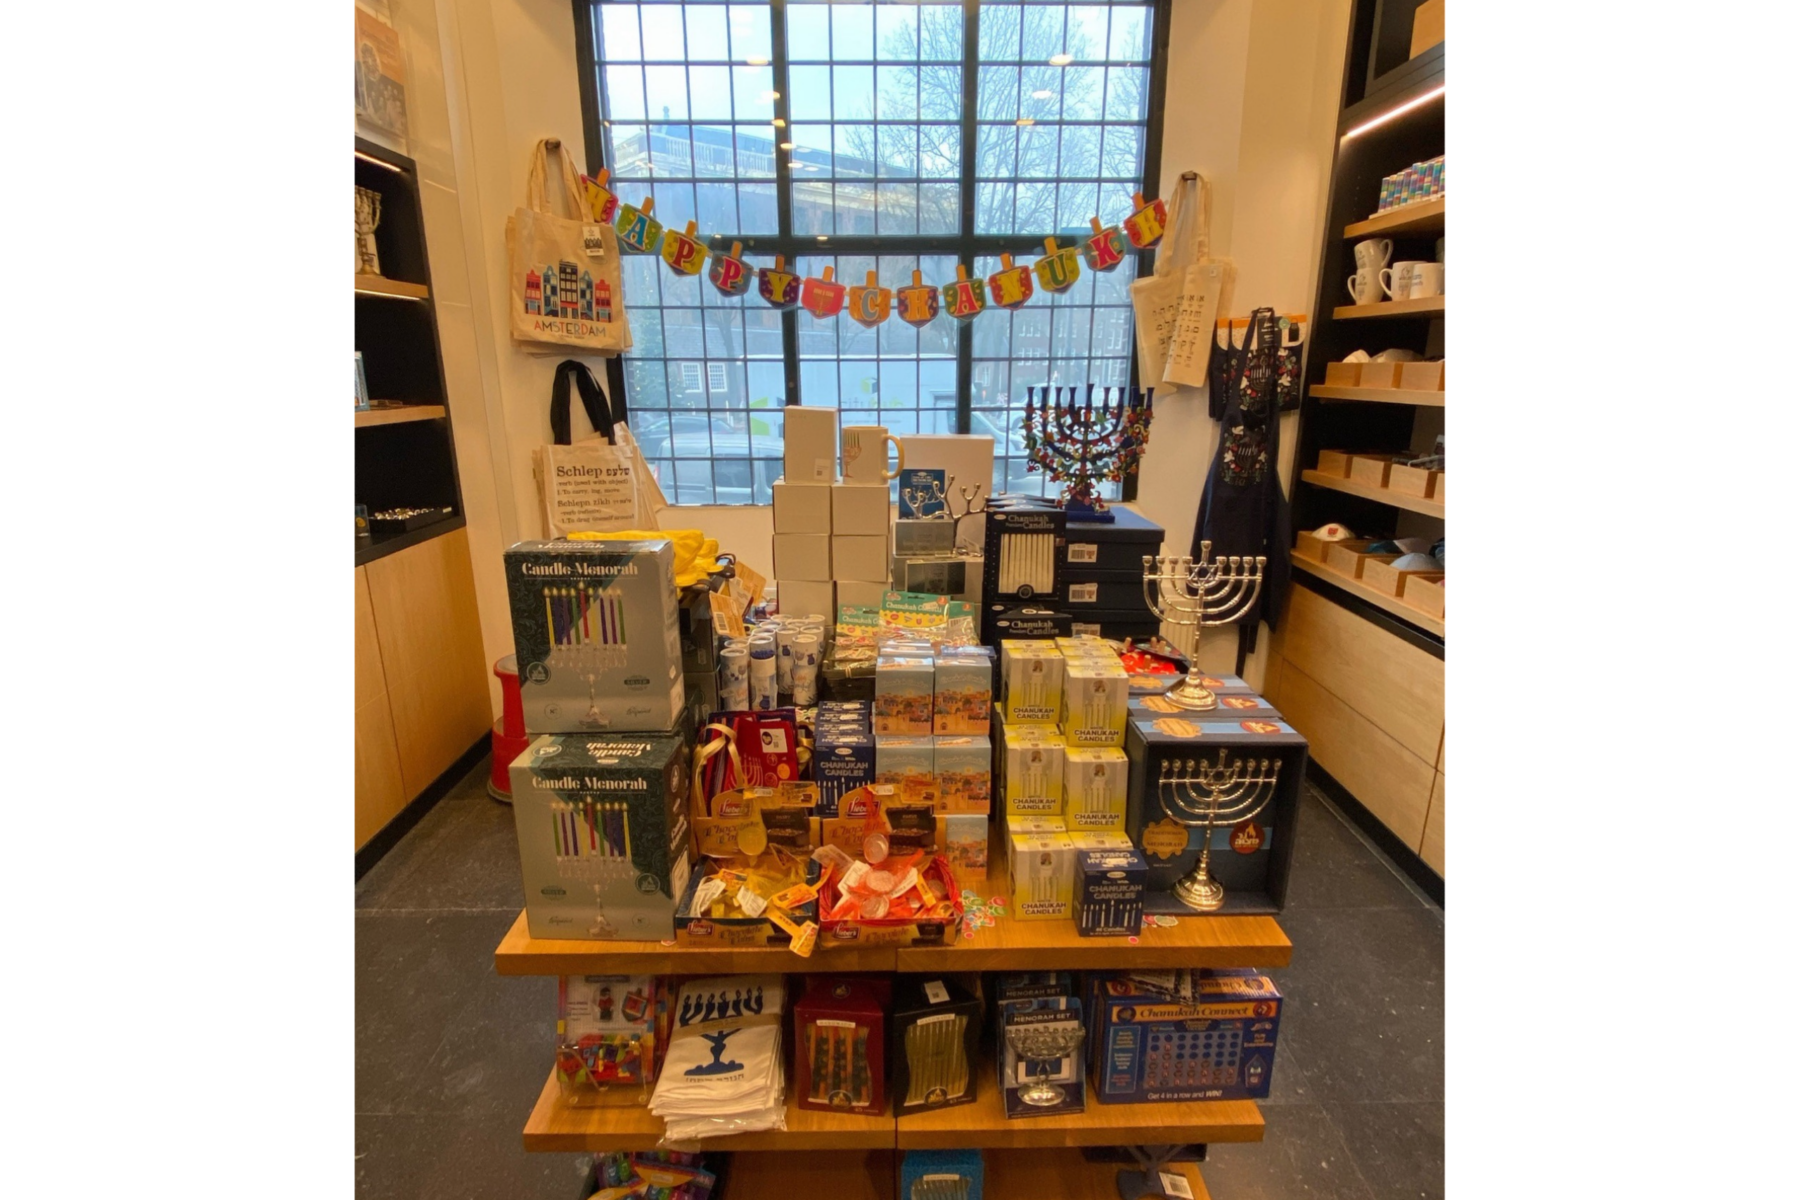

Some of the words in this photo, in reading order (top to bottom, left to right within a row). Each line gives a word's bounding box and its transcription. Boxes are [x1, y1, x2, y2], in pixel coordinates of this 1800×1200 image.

[534, 321, 607, 337] AMSTERDAM
[556, 465, 603, 478] Schlep
[1008, 514, 1049, 522] Chanukah
[1022, 521, 1055, 529] Candles
[522, 562, 572, 575] Candle
[575, 562, 639, 575] Menorah
[886, 601, 917, 611] Chanukah
[842, 615, 872, 625] Chanukah
[1011, 620, 1054, 629] Chanukah
[1026, 627, 1059, 635] Candles
[820, 761, 868, 769] CHANUKAH
[825, 769, 864, 777] CANDLES
[532, 776, 580, 790] Candle
[584, 777, 647, 790] Menorah
[1093, 892, 1136, 900] CANDLES
[1006, 989, 1045, 997] MENORAH
[1046, 987, 1061, 995] SET
[1140, 1005, 1200, 1018] Chanukah
[1201, 1005, 1248, 1017] Connect
[1013, 1014, 1054, 1023] MENORAH
[1056, 1012, 1071, 1020] SET
[1147, 1092, 1160, 1100] Get
[1166, 1091, 1172, 1099] in
[1192, 1091, 1205, 1099] and
